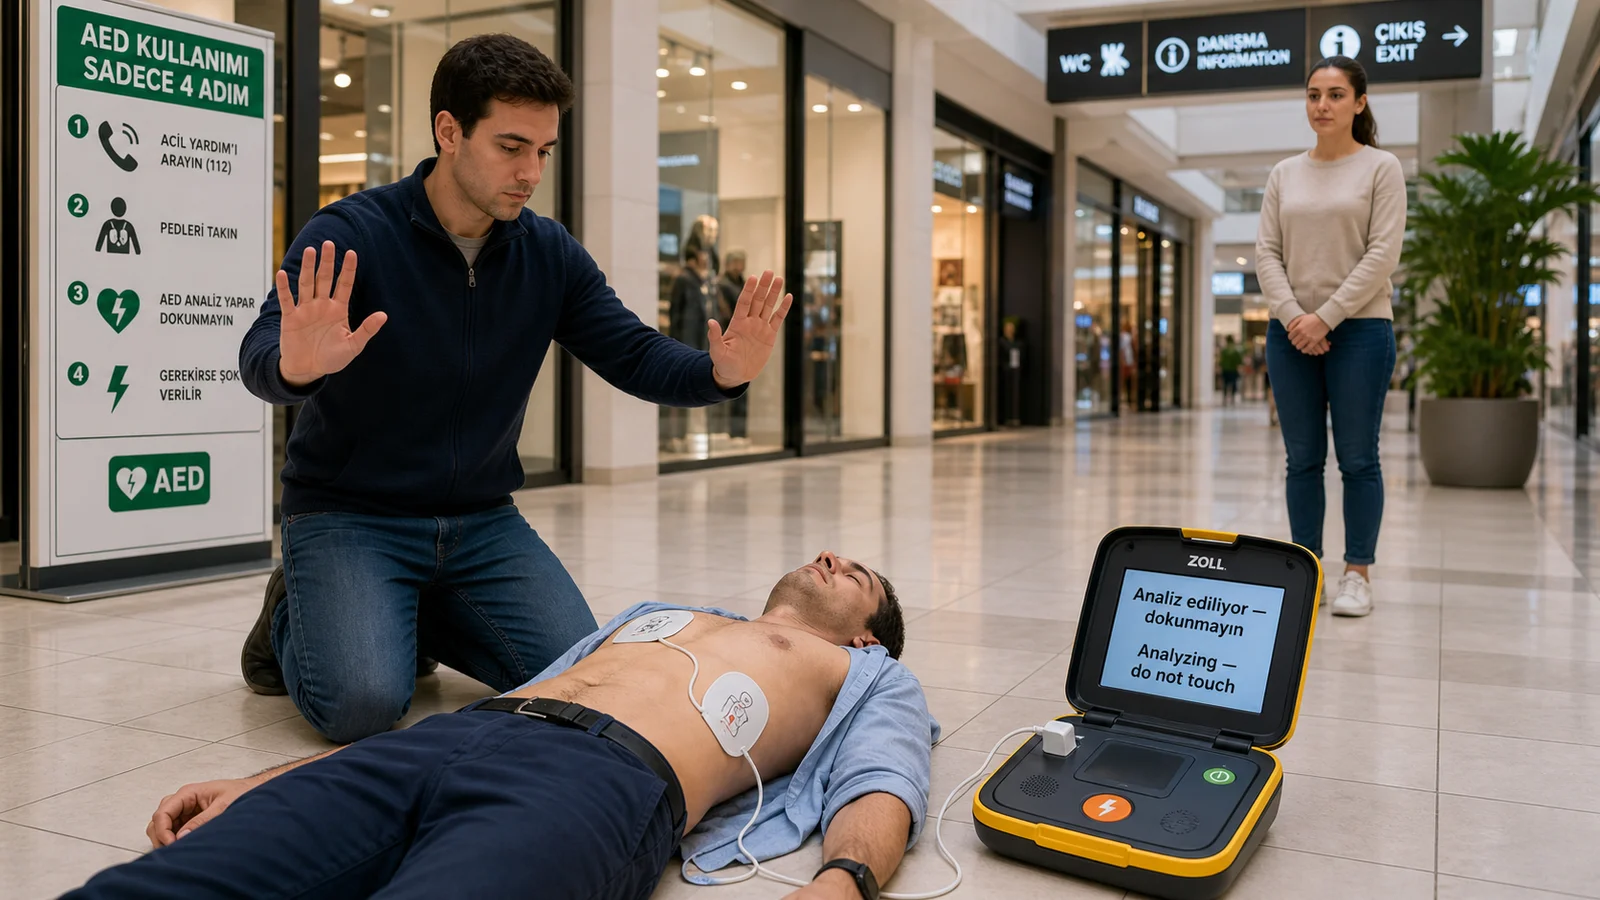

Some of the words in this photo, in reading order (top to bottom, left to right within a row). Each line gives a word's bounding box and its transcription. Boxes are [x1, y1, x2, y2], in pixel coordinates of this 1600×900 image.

[1197, 31, 1269, 53] DANIŞMA
[1375, 20, 1427, 44] ÇIKIŞ
[80, 22, 130, 53] AED
[136, 33, 249, 78] KULLANIMI
[1197, 48, 1291, 70] INFORMATION
[1376, 43, 1418, 63] EXIT
[1060, 54, 1091, 75] WC
[83, 56, 174, 94] SADECE
[180, 74, 194, 97] 4
[198, 78, 249, 107] ADIM
[73, 119, 82, 134] 1
[160, 133, 187, 149] ACİL
[160, 153, 203, 170] ARAYIN
[206, 159, 232, 175] (112)
[73, 198, 83, 213] 2
[160, 222, 205, 237] PEDLERİ
[207, 225, 238, 240] TAKIN
[73, 285, 83, 301] 3
[160, 293, 182, 306] AED
[184, 292, 222, 308] ANALİZ
[224, 296, 255, 309] YAPAR
[160, 312, 234, 326] DOKUNMAYIN
[73, 365, 84, 381] 4
[160, 367, 217, 382] GEREKİRSE
[219, 370, 240, 384] ŞOK
[160, 386, 202, 401] VERİLİR
[153, 466, 205, 493] AED
[1133, 587, 1182, 607] Analiz
[1186, 594, 1249, 617] ediliyor
[1144, 609, 1244, 637] dokunmayın
[1137, 644, 1218, 672] Analyzing
[1131, 663, 1151, 679] do
[1156, 670, 1184, 686] not
[1188, 672, 1235, 694] touch
